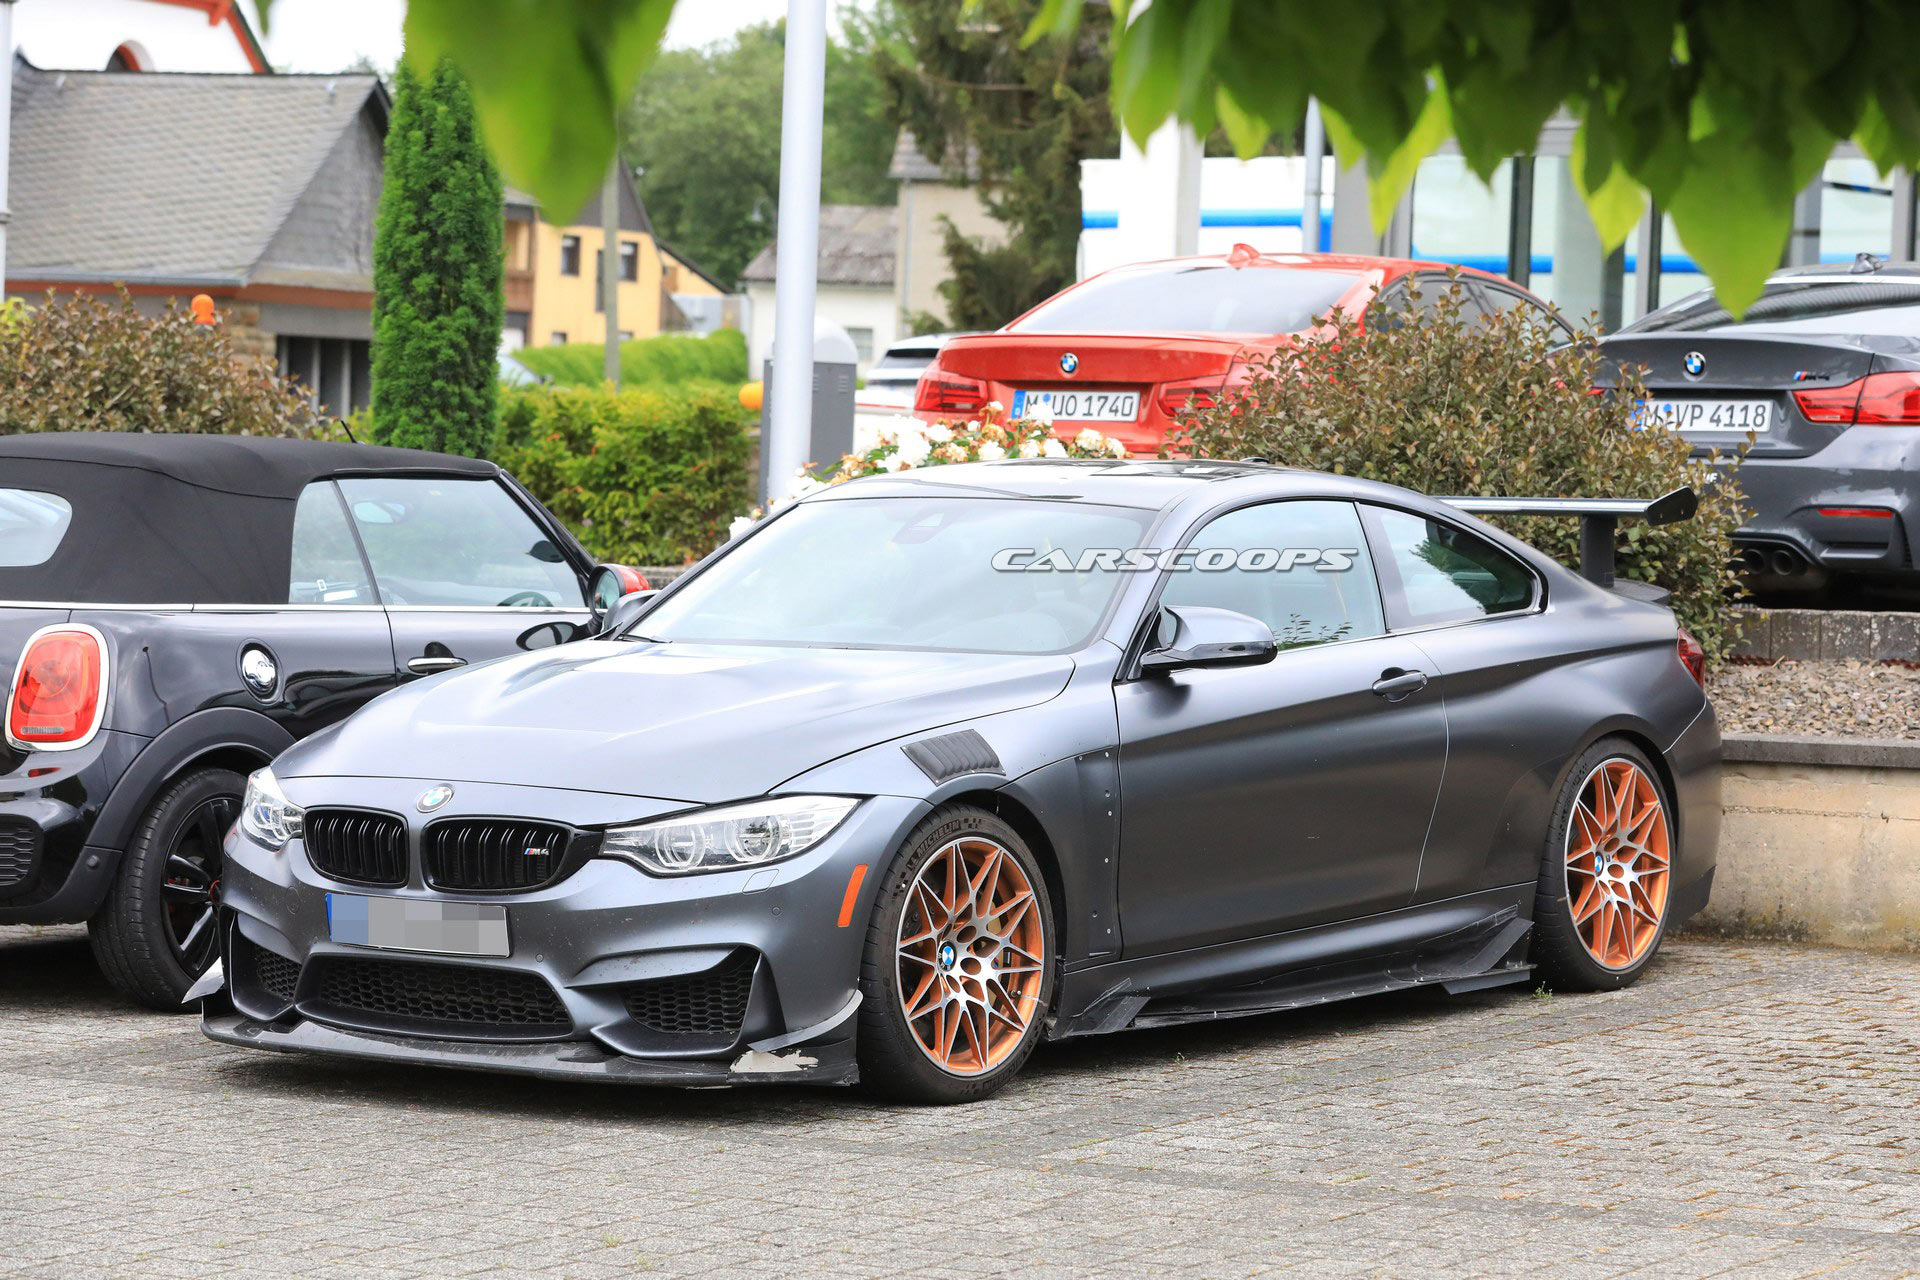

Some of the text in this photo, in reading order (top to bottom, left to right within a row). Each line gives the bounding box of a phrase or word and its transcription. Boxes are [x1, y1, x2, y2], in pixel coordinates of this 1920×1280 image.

[1052, 394, 1078, 417] UO
[1082, 395, 1134, 417] 1740
[1676, 403, 1704, 427] VP
[1709, 404, 1766, 427] 4118
[918, 820, 961, 857] MICHELIN
